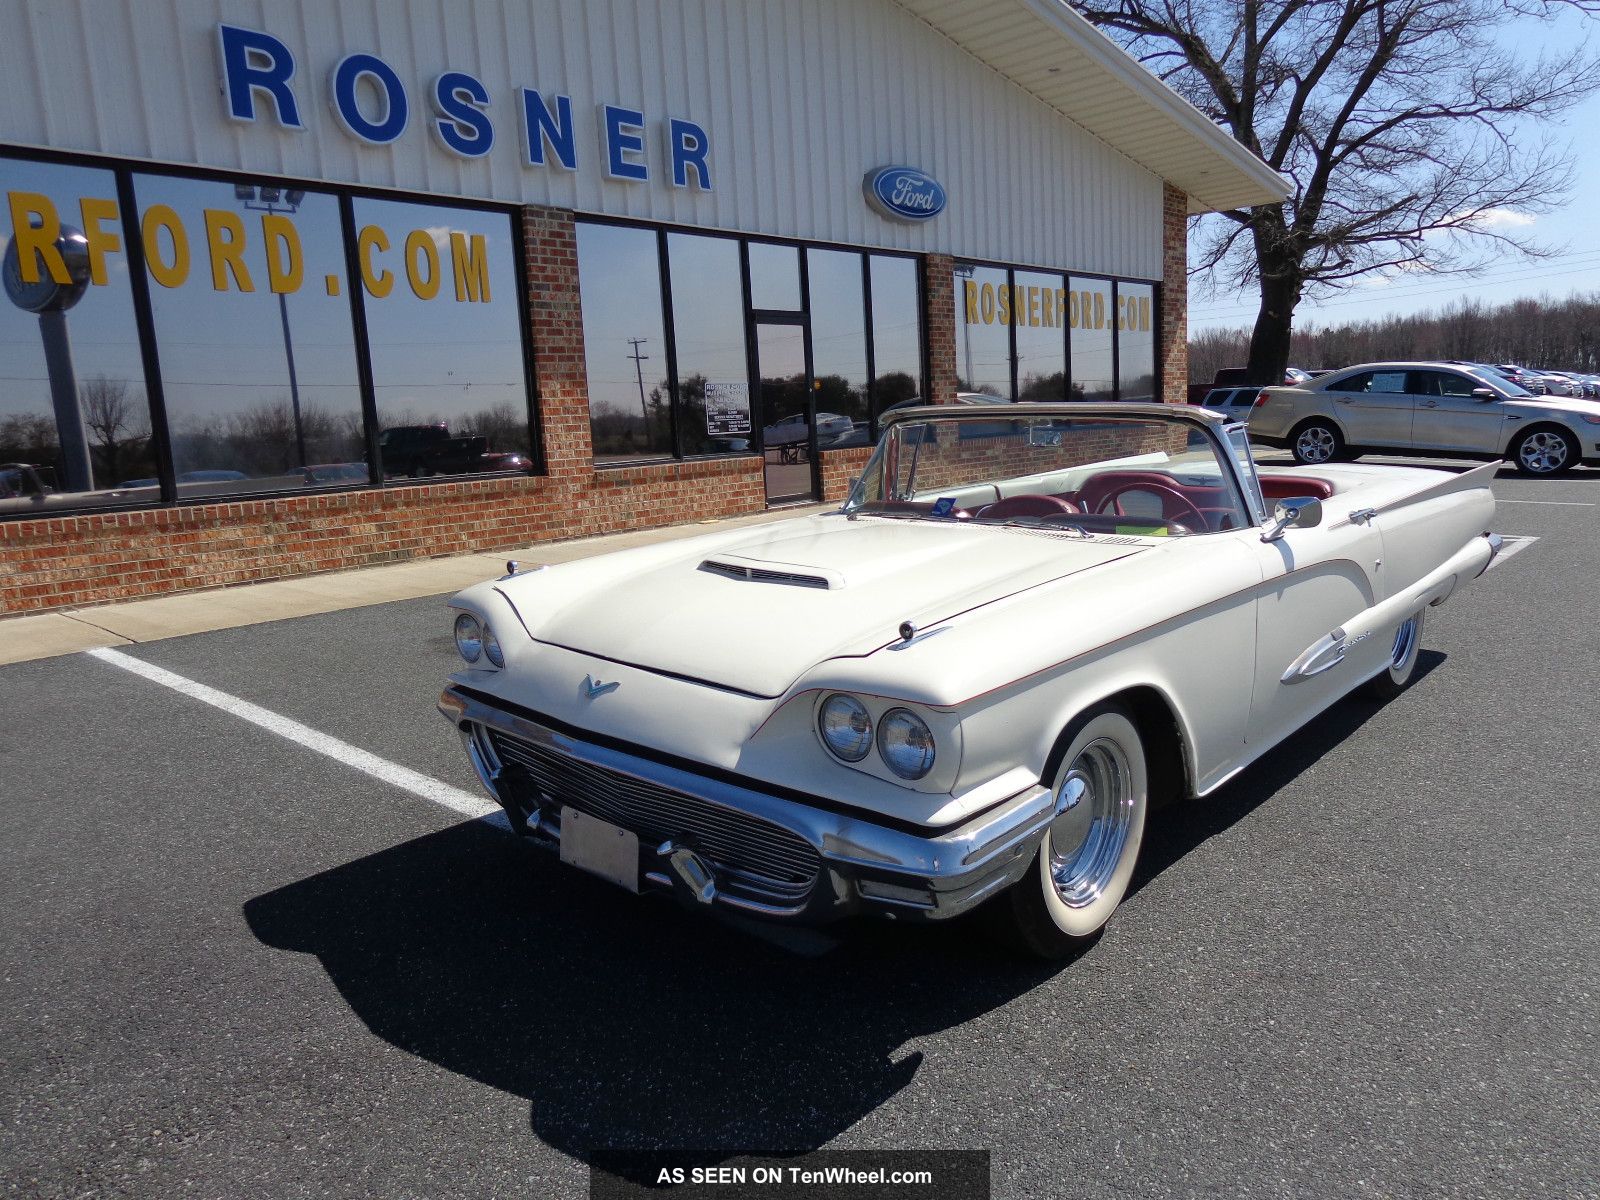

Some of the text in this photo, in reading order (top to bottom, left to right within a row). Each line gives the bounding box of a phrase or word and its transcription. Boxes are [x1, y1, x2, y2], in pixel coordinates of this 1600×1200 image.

[217, 23, 713, 193] ROSNER
[892, 176, 934, 210] Ford
[8, 191, 492, 303] RFORD.COM
[965, 280, 1151, 332] ROSNERFORD.COM
